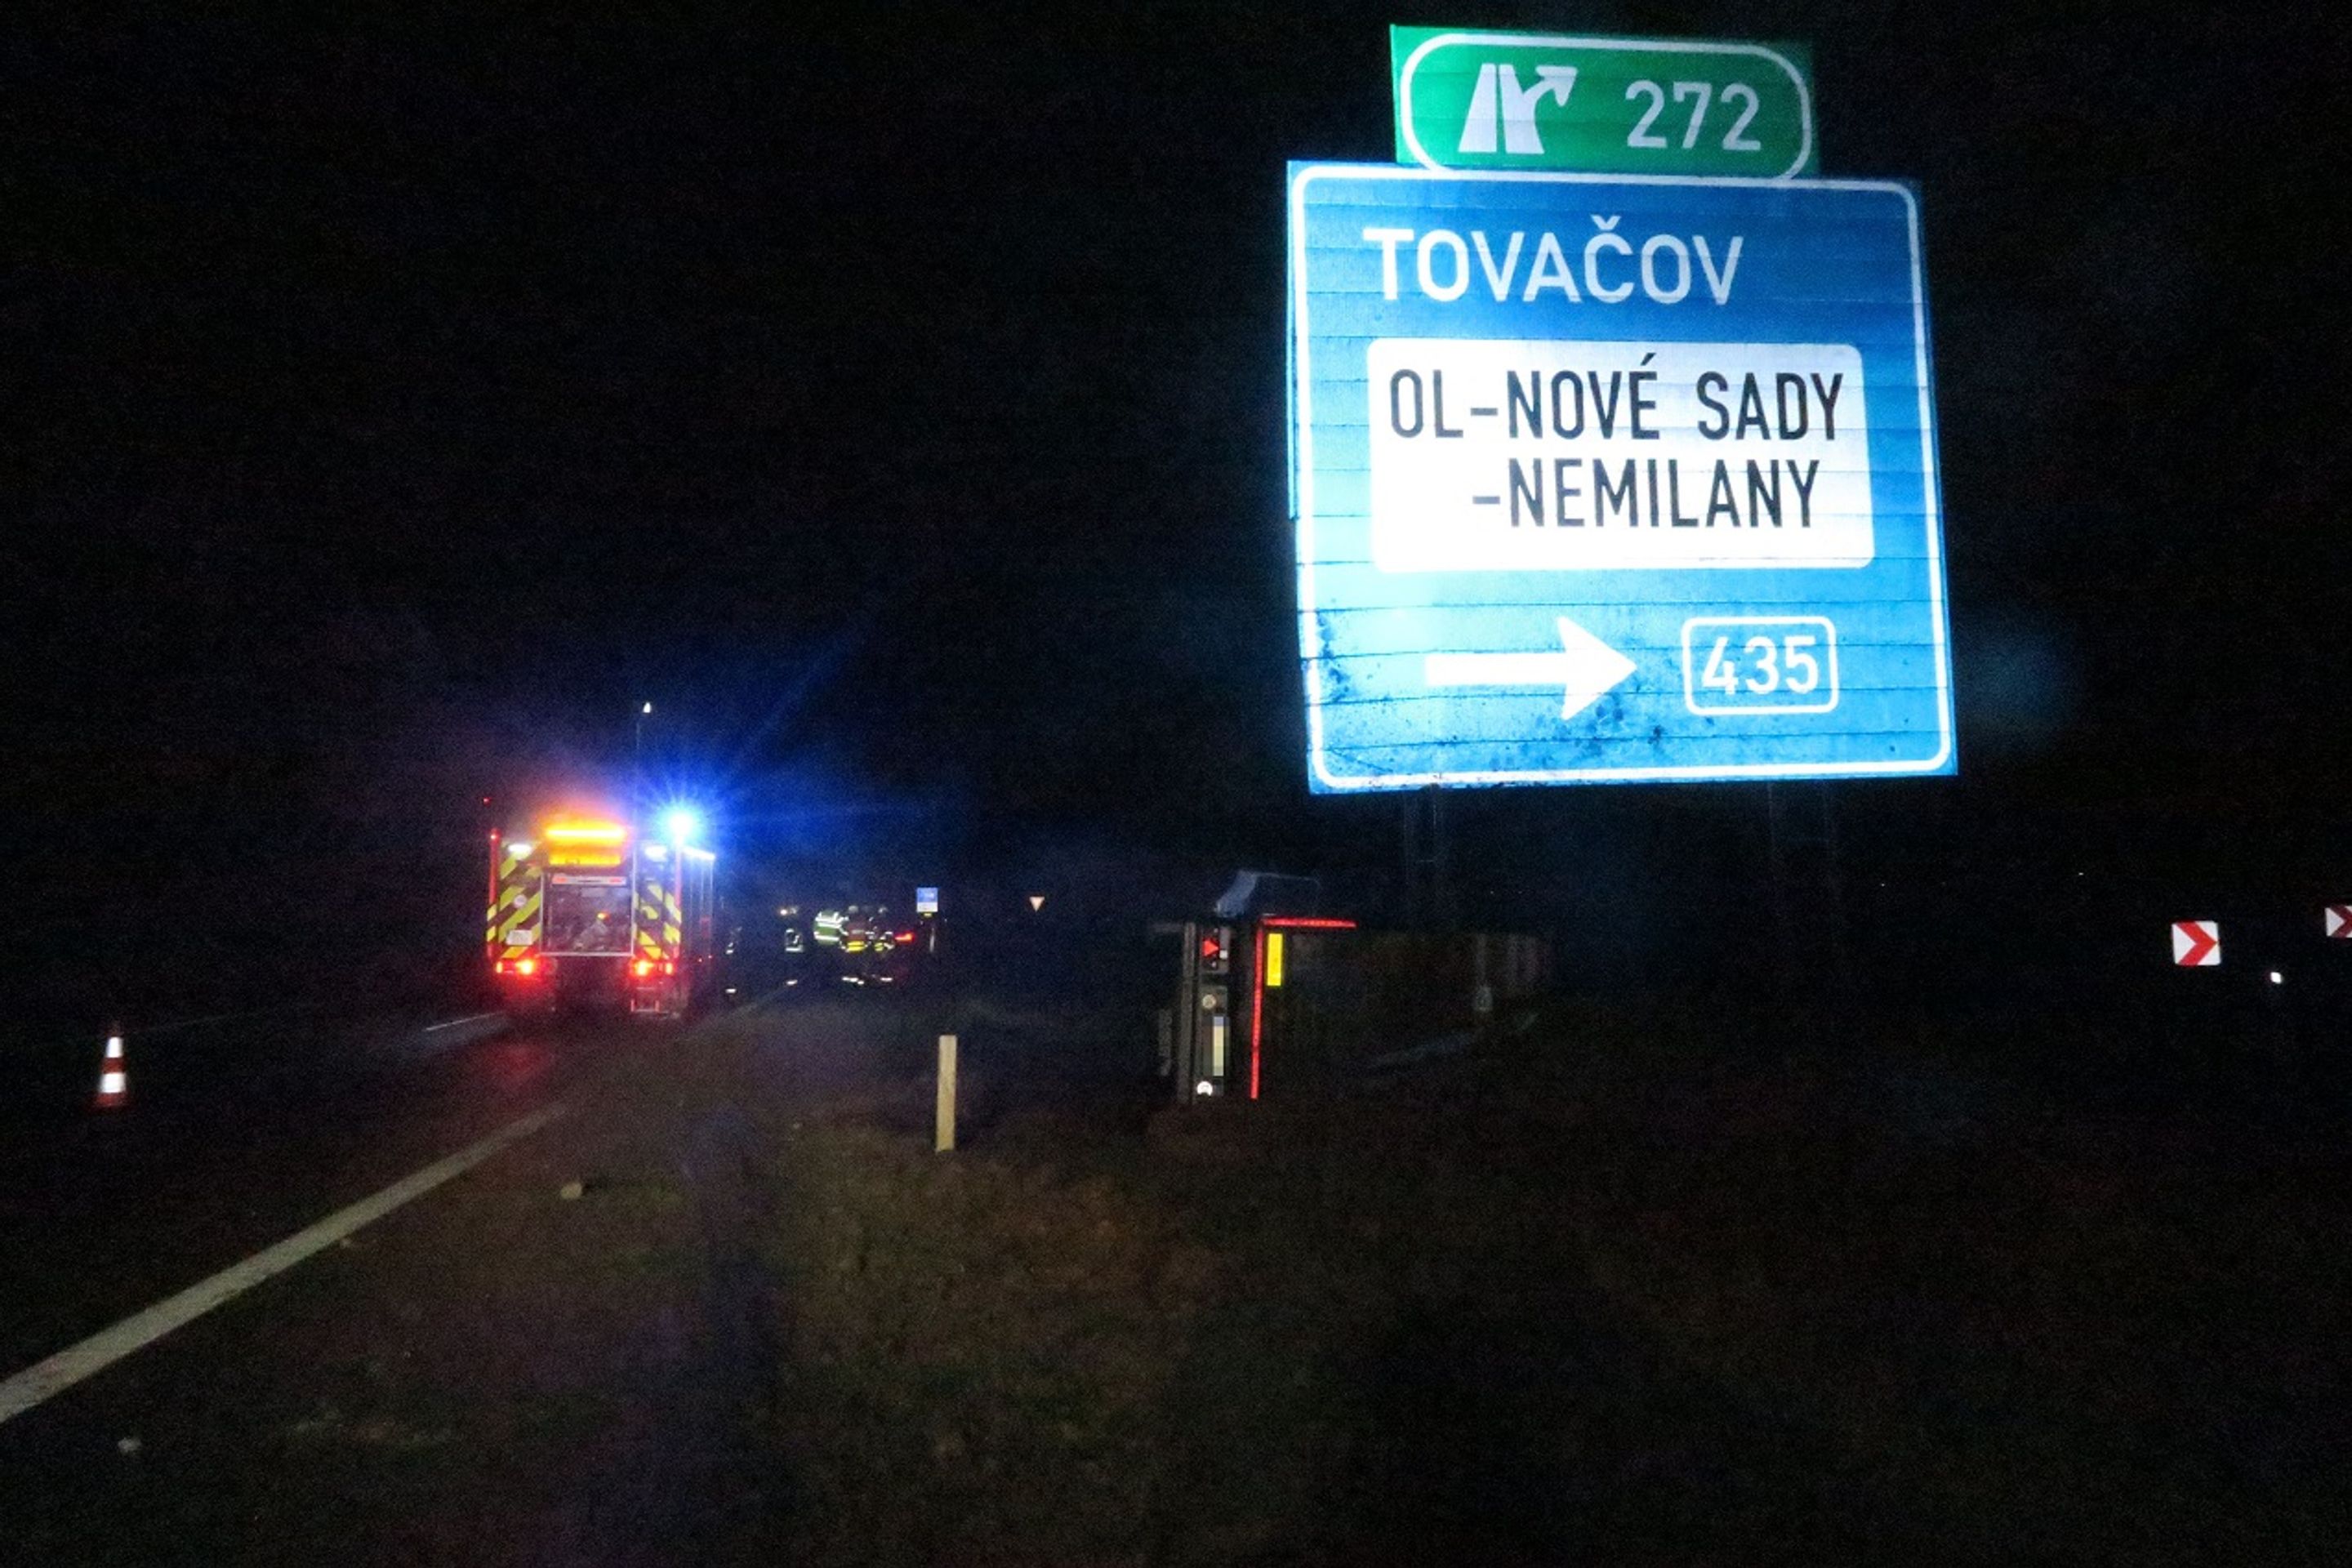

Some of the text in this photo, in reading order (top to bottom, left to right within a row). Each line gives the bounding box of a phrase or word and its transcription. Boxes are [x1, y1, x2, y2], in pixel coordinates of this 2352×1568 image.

[1625, 80, 1762, 152] 272
[1363, 214, 1744, 305] TOVAČOV
[1390, 352, 1845, 443] OL-NOVÉ SADY
[1472, 457, 1820, 530] -NEMILANY
[1701, 635, 1820, 697] 435
